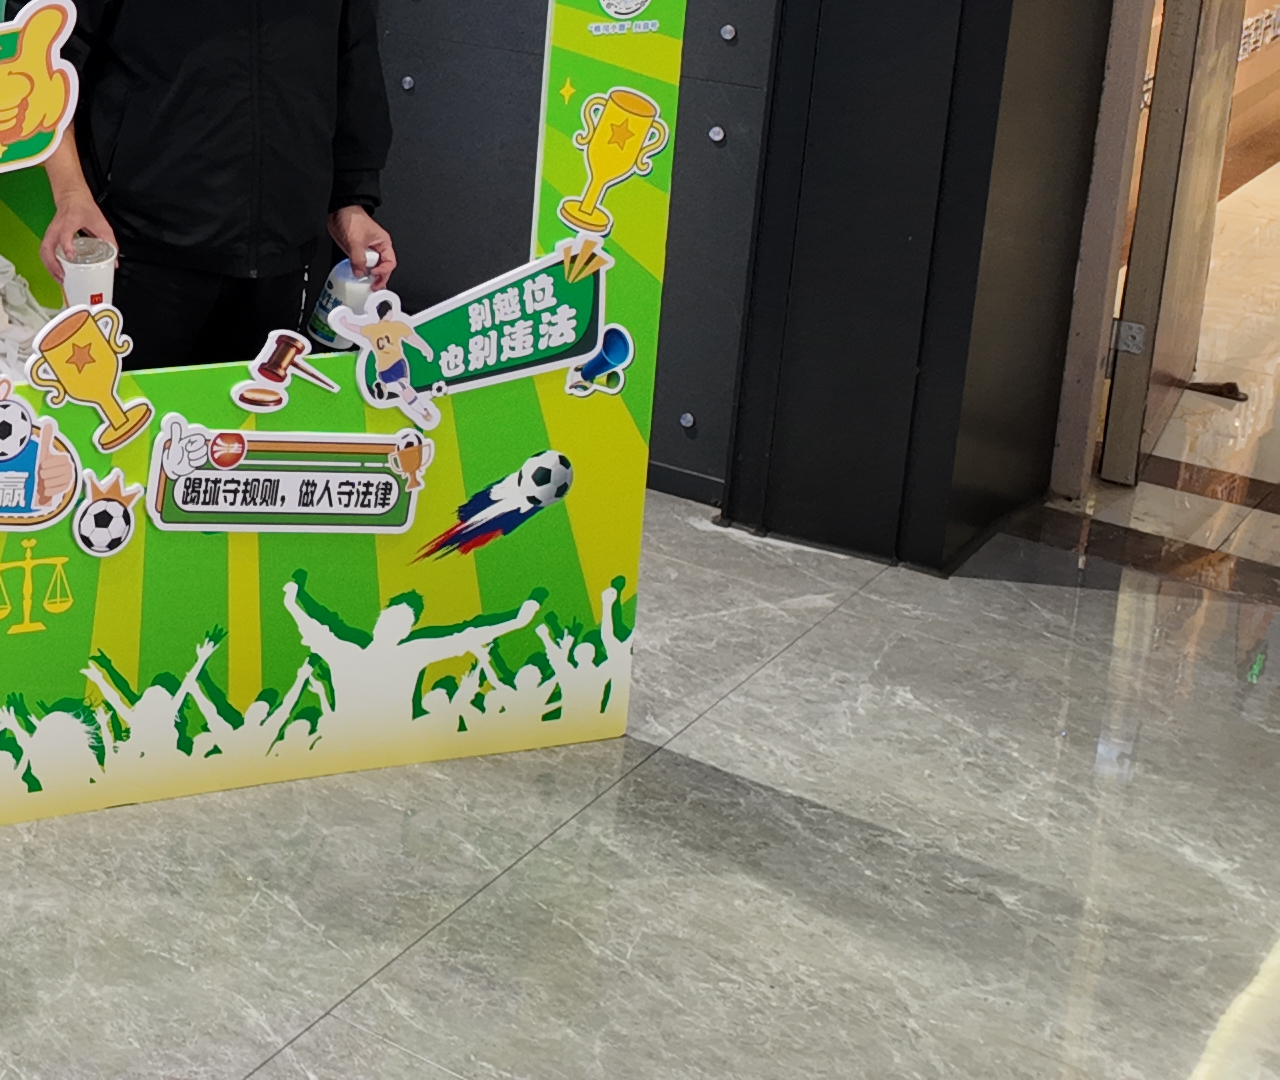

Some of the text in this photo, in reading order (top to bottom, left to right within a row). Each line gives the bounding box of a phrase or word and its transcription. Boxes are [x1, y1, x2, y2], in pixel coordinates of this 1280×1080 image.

[468, 273, 558, 333] 别越位
[439, 304, 577, 378] 也别违法
